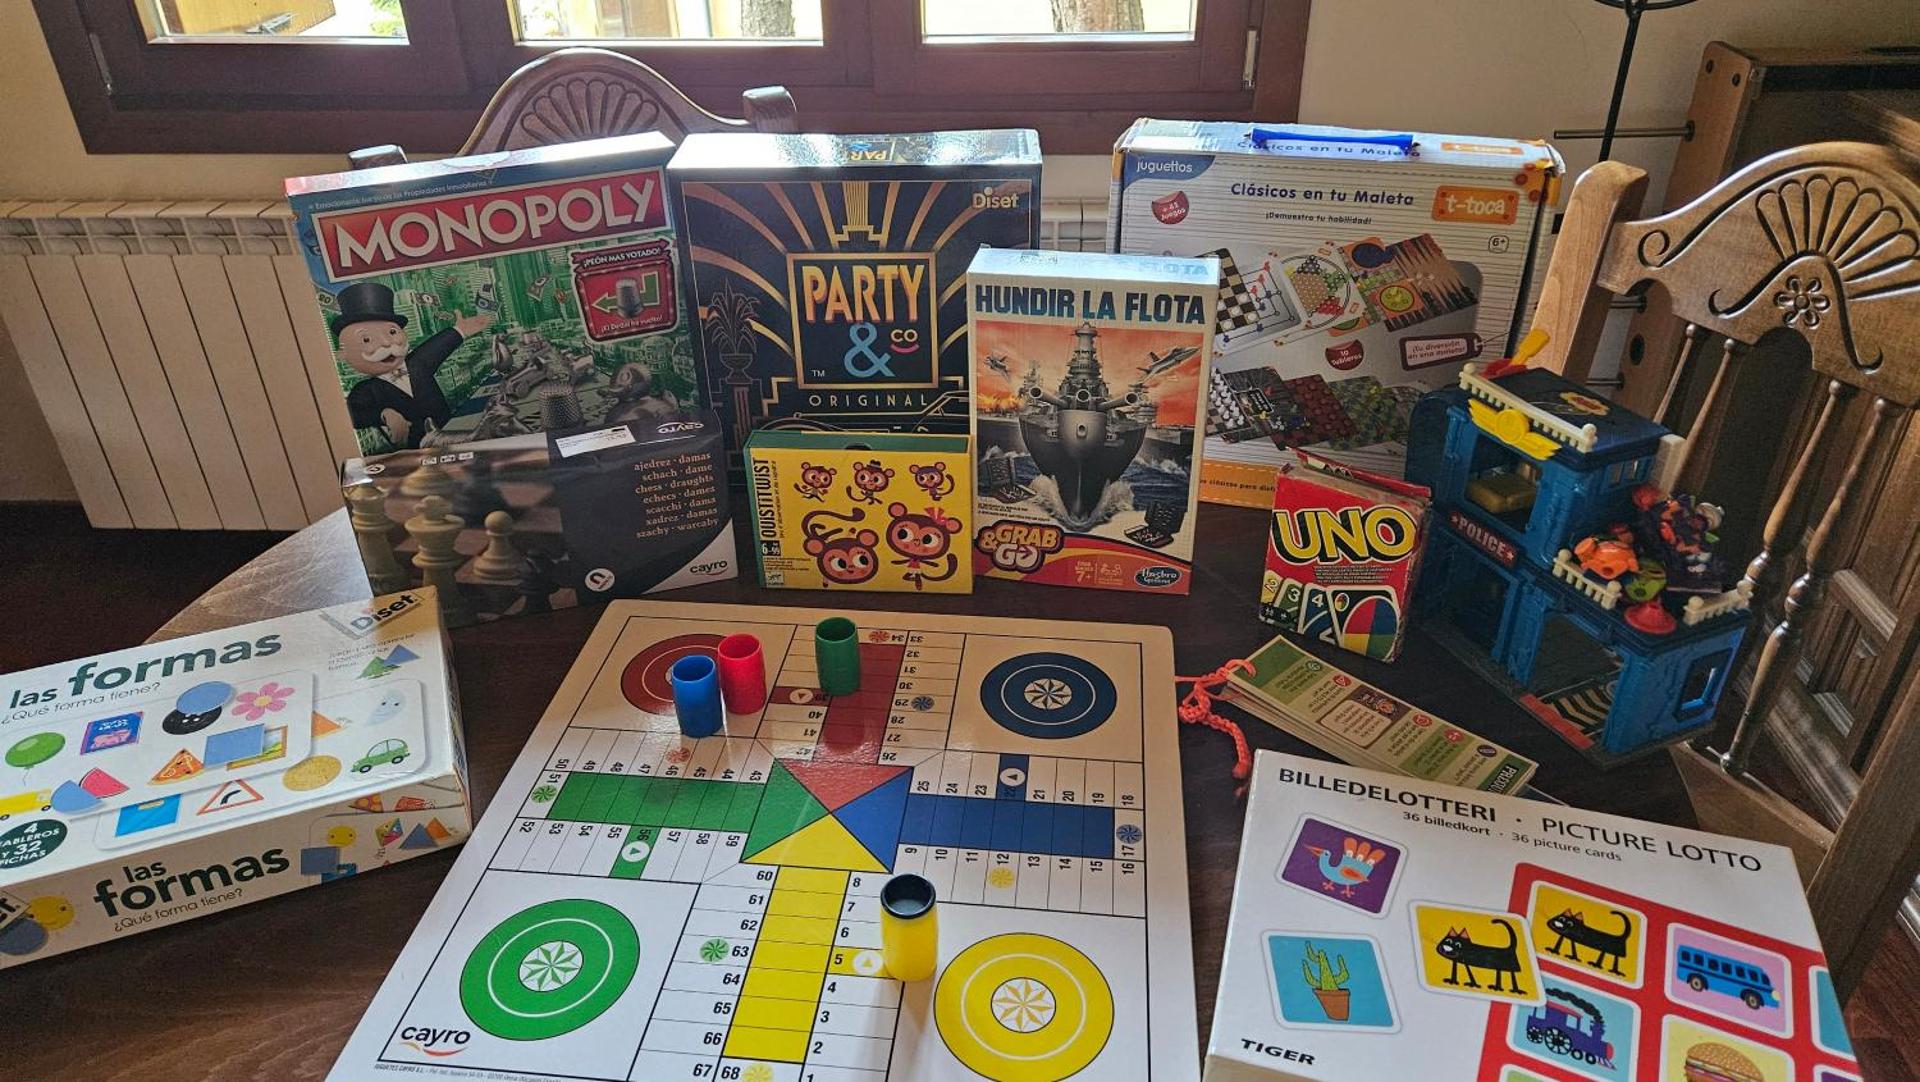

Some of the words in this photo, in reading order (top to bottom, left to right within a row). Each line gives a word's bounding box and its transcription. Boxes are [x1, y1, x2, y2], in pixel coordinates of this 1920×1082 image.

[1336, 146, 1352, 154] tu
[1361, 147, 1421, 157] Maleta
[1136, 160, 1193, 173] juguettos
[972, 187, 1019, 209] Diset
[1231, 181, 1296, 200] Clásicos
[1303, 189, 1322, 201] en
[1331, 188, 1347, 202] tu
[1354, 190, 1414, 206] Maleta
[1445, 195, 1506, 215] t-toca
[336, 178, 655, 268] MONOPOLY
[1265, 211, 1314, 222] ¡Demuestra
[1317, 214, 1326, 222] tu
[1328, 215, 1372, 225] habilidad!
[1491, 237, 1507, 247] 6+
[801, 264, 926, 324] PARTY
[975, 285, 1075, 318] HUNDIR
[1082, 290, 1117, 321] LA
[1125, 291, 1206, 325] FLOTA
[844, 322, 896, 378] &
[809, 394, 928, 408] ORIGINAL
[634, 459, 672, 473] ajedrez
[679, 451, 712, 464] damas
[642, 469, 678, 482] schach
[686, 463, 713, 475] dame
[635, 483, 663, 495] chess
[670, 474, 714, 489] draughts
[683, 485, 716, 498] dames
[646, 501, 682, 515] scacchi
[689, 495, 716, 508] dama
[646, 513, 679, 526] xadrez
[686, 507, 718, 519] damas
[636, 524, 669, 538] szachy
[678, 518, 718, 532] warcaby
[995, 525, 1058, 548] GRAB
[1271, 505, 1418, 565] UNO
[1458, 515, 1506, 558] POLICE
[995, 543, 1038, 568] GO
[690, 559, 728, 573] cayro
[1288, 588, 1300, 602] 3
[1311, 593, 1324, 608] 4
[350, 594, 417, 630] Diset
[891, 634, 904, 642] 34
[906, 650, 920, 658] 32
[9, 687, 57, 709] las
[68, 632, 282, 697] formas
[904, 666, 917, 674] 31
[899, 681, 913, 690] 30
[1, 705, 50, 724] ¿Qué
[54, 695, 105, 713] forma
[109, 682, 161, 700] tiene?
[895, 698, 909, 707] 29
[808, 711, 823, 719] 40
[890, 716, 905, 724] 28
[803, 728, 817, 737] 41
[886, 733, 901, 742] 27
[881, 752, 897, 761] 26
[557, 758, 570, 770] 50
[585, 760, 596, 772] 49
[638, 763, 651, 774] 47
[665, 765, 678, 776] 46
[694, 766, 706, 778] 45
[721, 768, 734, 780] 44
[750, 770, 762, 782] 43
[548, 773, 561, 784] 51
[918, 780, 930, 791] 25
[946, 782, 958, 794] 24
[975, 785, 988, 796] 23
[1033, 789, 1046, 800] 21
[1062, 791, 1075, 802] 20
[1092, 793, 1105, 804] 19
[1122, 795, 1134, 806] 18
[1279, 768, 1497, 822] BILLEDELOTTERI
[1541, 817, 1657, 852] PICTURE
[1666, 841, 1762, 872] LOTTO
[24, 822, 38, 833] 4
[519, 821, 535, 833] 52
[549, 823, 564, 835] 53
[578, 824, 593, 837] 54
[607, 826, 623, 839] 55
[637, 828, 651, 841] 56
[668, 830, 682, 843] 57
[696, 832, 710, 845] 58
[725, 834, 740, 847] 59
[1403, 811, 1420, 822] 36
[1424, 815, 1491, 836] billedkort
[1511, 832, 1529, 844] 36
[1534, 837, 1581, 854] picture
[1585, 848, 1622, 861] cards
[13, 840, 42, 855] 32
[1122, 845, 1135, 857] 17
[935, 849, 948, 861] 10
[966, 851, 979, 863] 11
[997, 853, 1010, 865] 12
[1028, 856, 1041, 868] 13
[1060, 858, 1071, 870] 14
[1091, 860, 1103, 872] 15
[122, 861, 167, 883] las
[1122, 863, 1135, 875] 16
[757, 870, 773, 881] 60
[93, 848, 291, 918] formas
[853, 877, 861, 888] 8
[749, 894, 764, 905] 61
[114, 913, 153, 932] ¿Qué
[154, 902, 198, 918] forma
[200, 888, 243, 906] tiene?
[848, 902, 855, 912] 7
[740, 919, 758, 931] 62
[840, 927, 849, 938] 6
[732, 946, 750, 958] 63
[834, 954, 843, 965] 5
[722, 973, 741, 985] 64
[827, 981, 836, 994] 4
[713, 1002, 731, 1014] 65
[820, 1011, 829, 1023] 3
[400, 1024, 471, 1047] cayro
[703, 1032, 722, 1045] 66
[813, 1041, 823, 1054] 2
[1240, 1038, 1316, 1065] TIGER
[693, 1063, 712, 1078] 67
[721, 1066, 740, 1080] 68
[807, 1073, 814, 1082] 1
